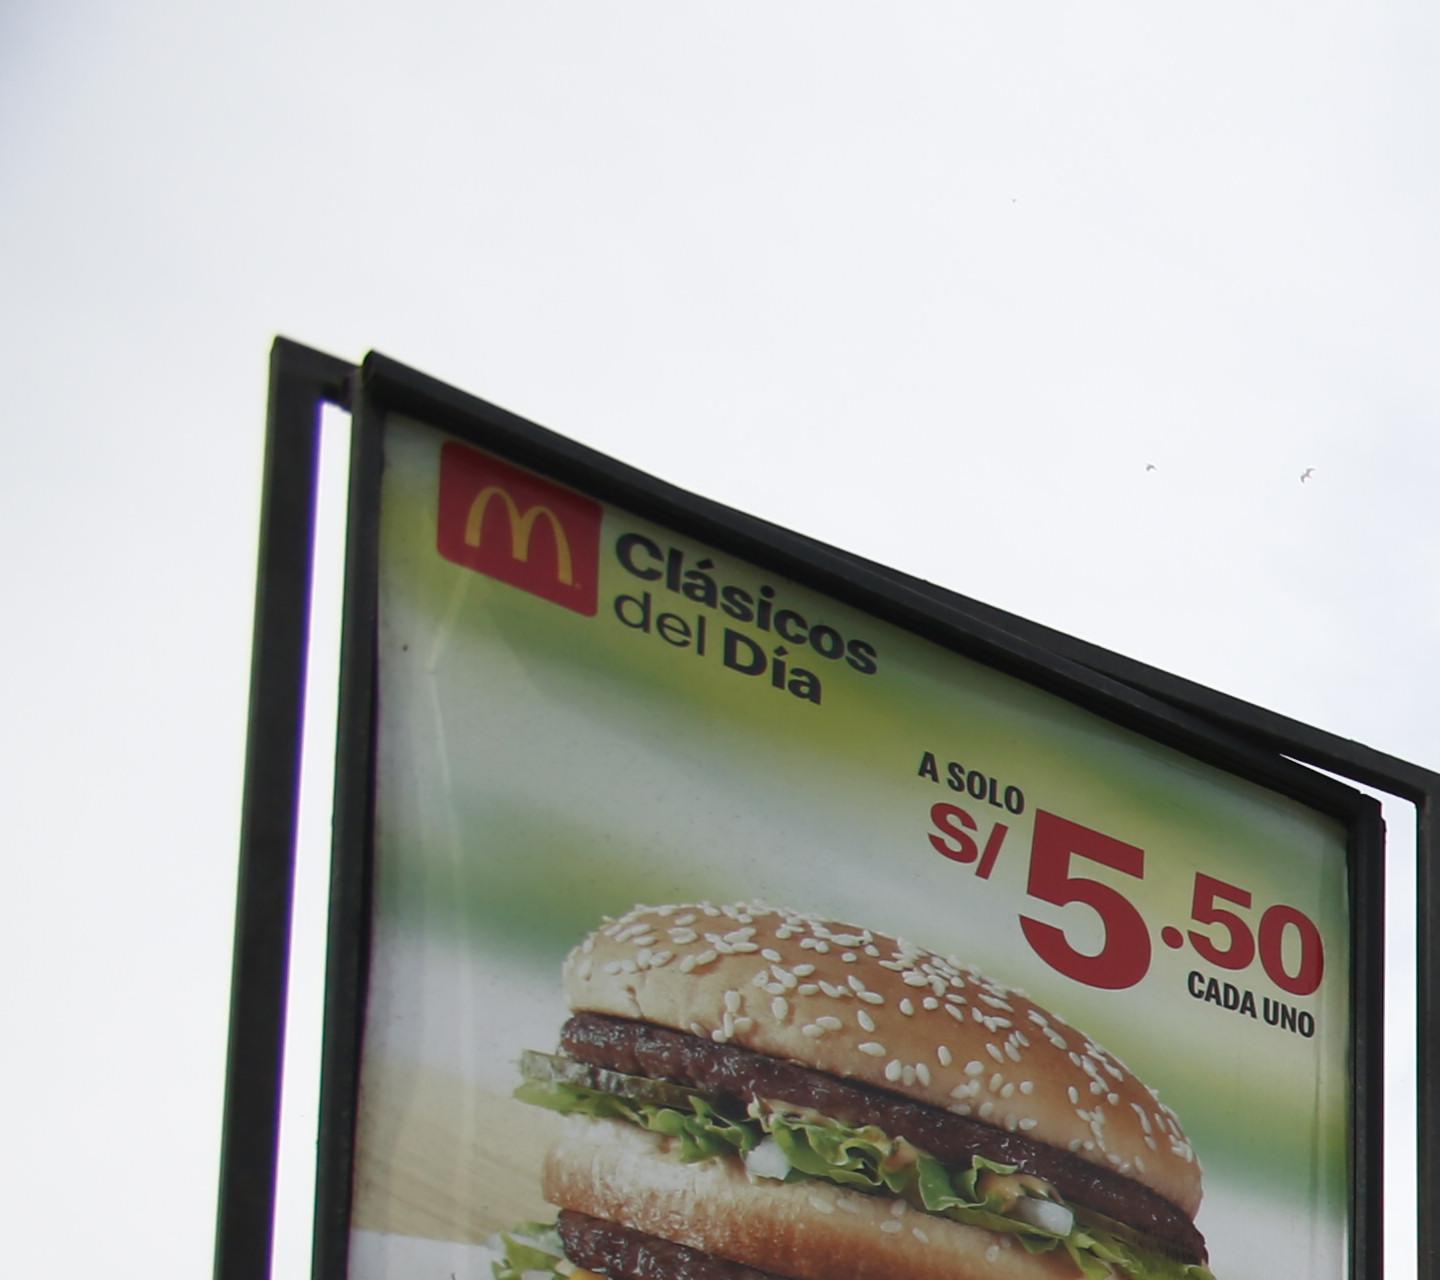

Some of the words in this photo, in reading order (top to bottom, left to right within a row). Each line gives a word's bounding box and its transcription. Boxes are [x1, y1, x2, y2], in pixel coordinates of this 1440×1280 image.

[613, 531, 878, 677] Clásicos
[613, 591, 708, 657] del
[720, 630, 823, 705] Día
[917, 752, 939, 783] A
[946, 759, 1025, 816] SOLO
[1187, 969, 1257, 1022] CADA
[1262, 990, 1316, 1039] UNO
